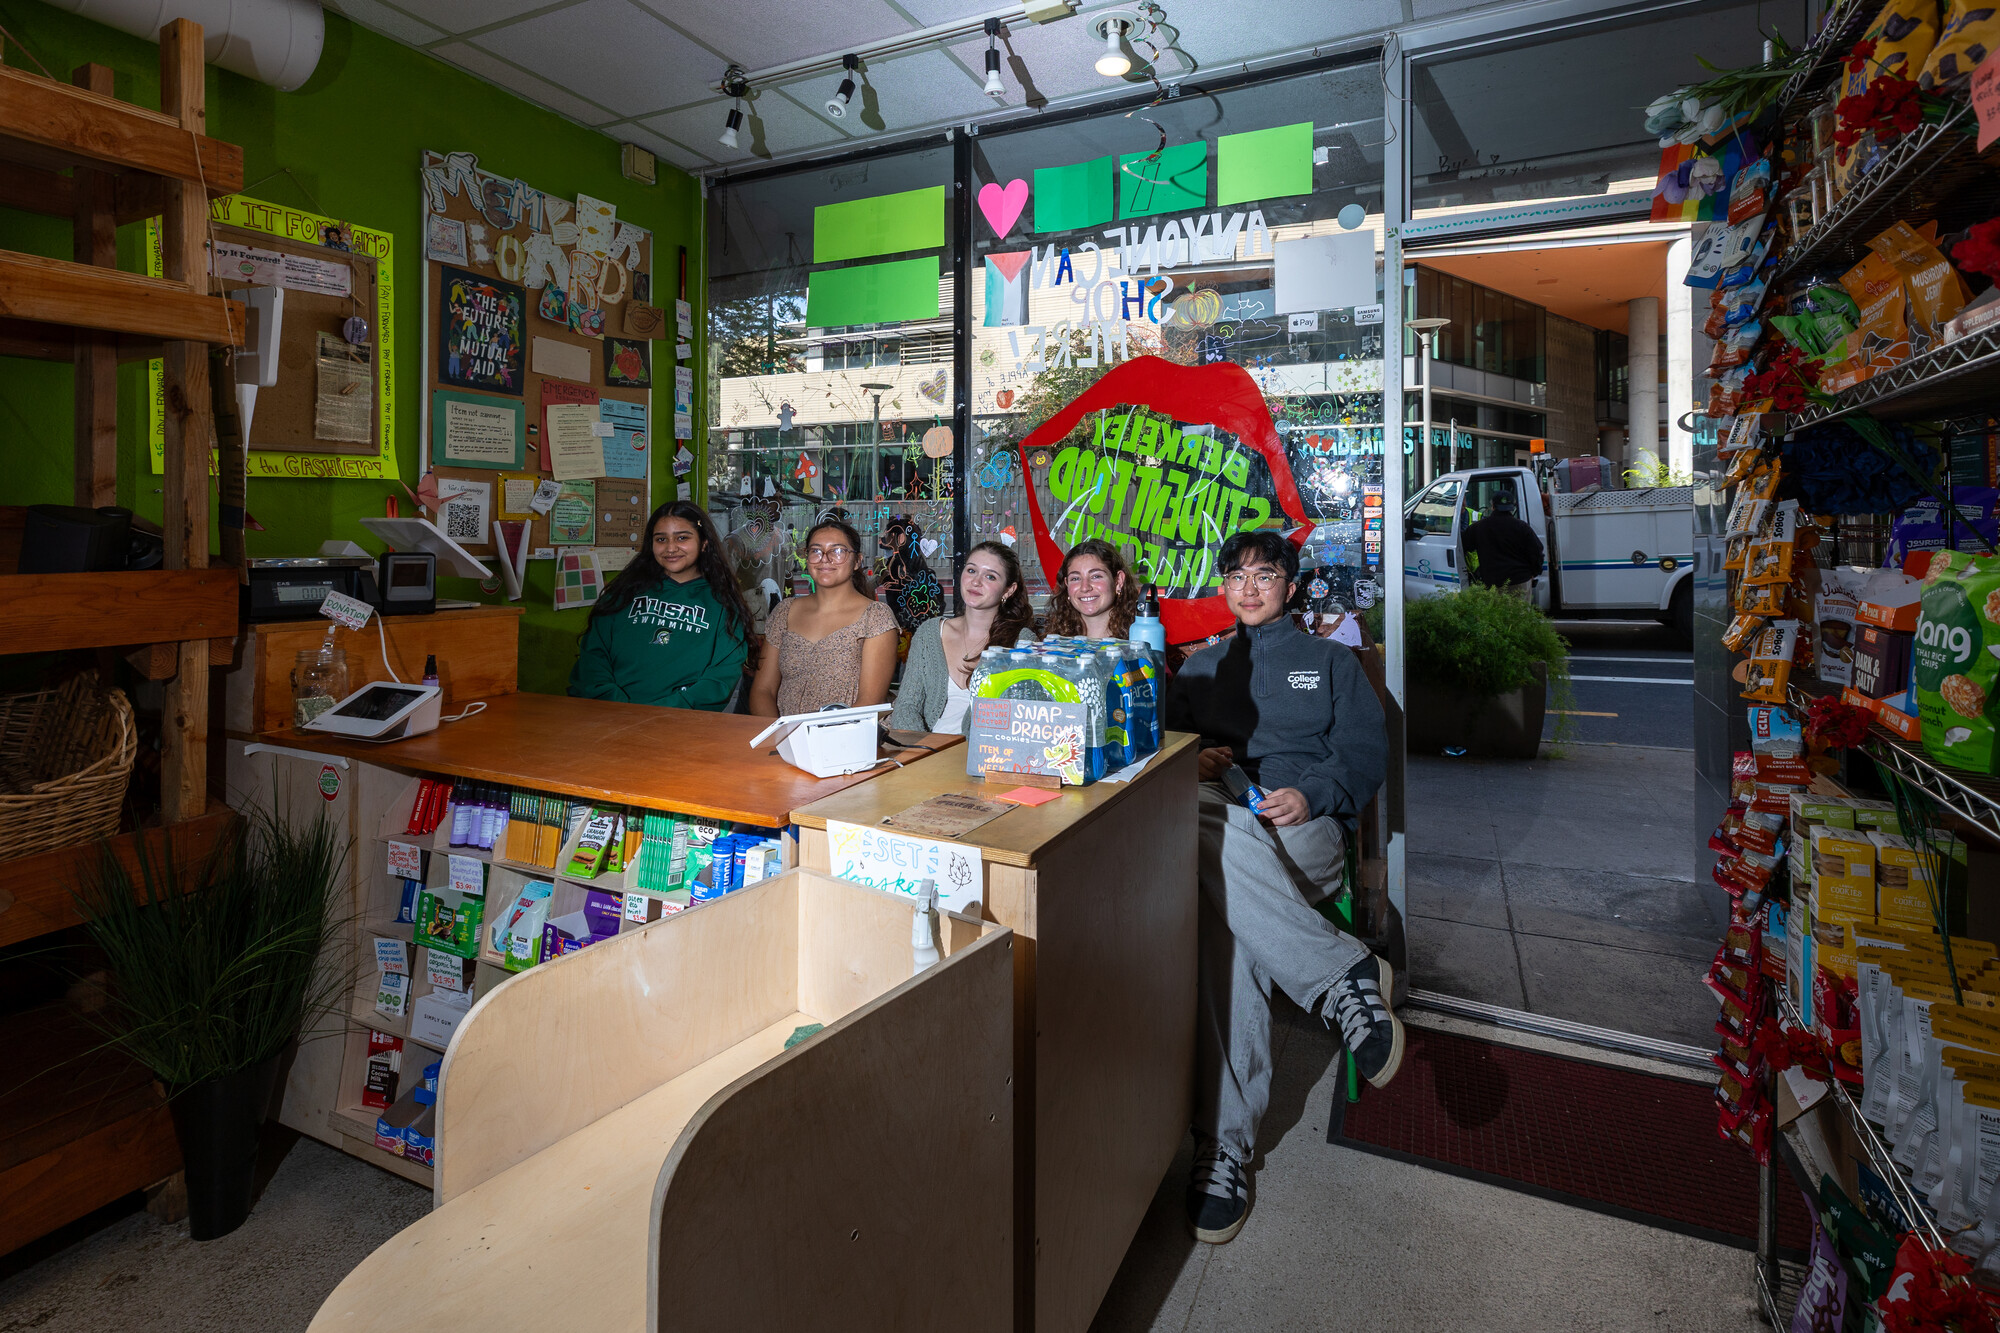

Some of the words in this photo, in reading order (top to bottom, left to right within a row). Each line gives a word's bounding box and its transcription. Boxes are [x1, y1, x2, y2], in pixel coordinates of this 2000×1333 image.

[241, 201, 281, 232] IT
[240, 252, 281, 264] Forward!
[475, 291, 498, 311] THE
[462, 306, 509, 332] FUTURE
[1299, 318, 1315, 328] Pay
[480, 326, 491, 343] IS
[460, 340, 510, 364] MUTUAL
[473, 359, 497, 376] AID
[542, 382, 597, 400] EMERGENCY
[260, 456, 283, 474] the
[1906, 537, 1947, 549] JOYRIDE
[1823, 583, 1859, 603] Justin's
[326, 598, 370, 622] DONATION
[628, 595, 710, 630] ALISAL
[632, 616, 702, 634] SWIMMING
[1773, 628, 1785, 656] BOBO'S
[1916, 647, 1930, 660] THAI
[1930, 651, 1947, 663] RICE
[1855, 650, 1874, 673] DARK
[1872, 659, 1881, 678] &
[1921, 658, 1939, 670] CHIPS
[1287, 675, 1321, 684] College
[1292, 682, 1318, 691] Corps
[1856, 673, 1876, 694] SALTY
[978, 703, 1009, 711] OAKLAND
[1014, 703, 1062, 723] SNAP
[977, 718, 1008, 726] FACTORY
[1757, 710, 1769, 729] CLIF
[995, 734, 1030, 744] cookies
[978, 744, 1000, 755] ITEM
[978, 764, 1005, 774] WEEK
[696, 817, 717, 827] alter
[582, 832, 605, 842] SANDWICH
[587, 828, 606, 836] GRAHAM
[698, 826, 714, 835] eco
[873, 836, 923, 869] SET
[1830, 886, 1863, 898] COOKIES
[1893, 897, 1927, 908] COOKIES
[424, 1013, 440, 1023] SIMPLY
[440, 1019, 452, 1027] GUM
